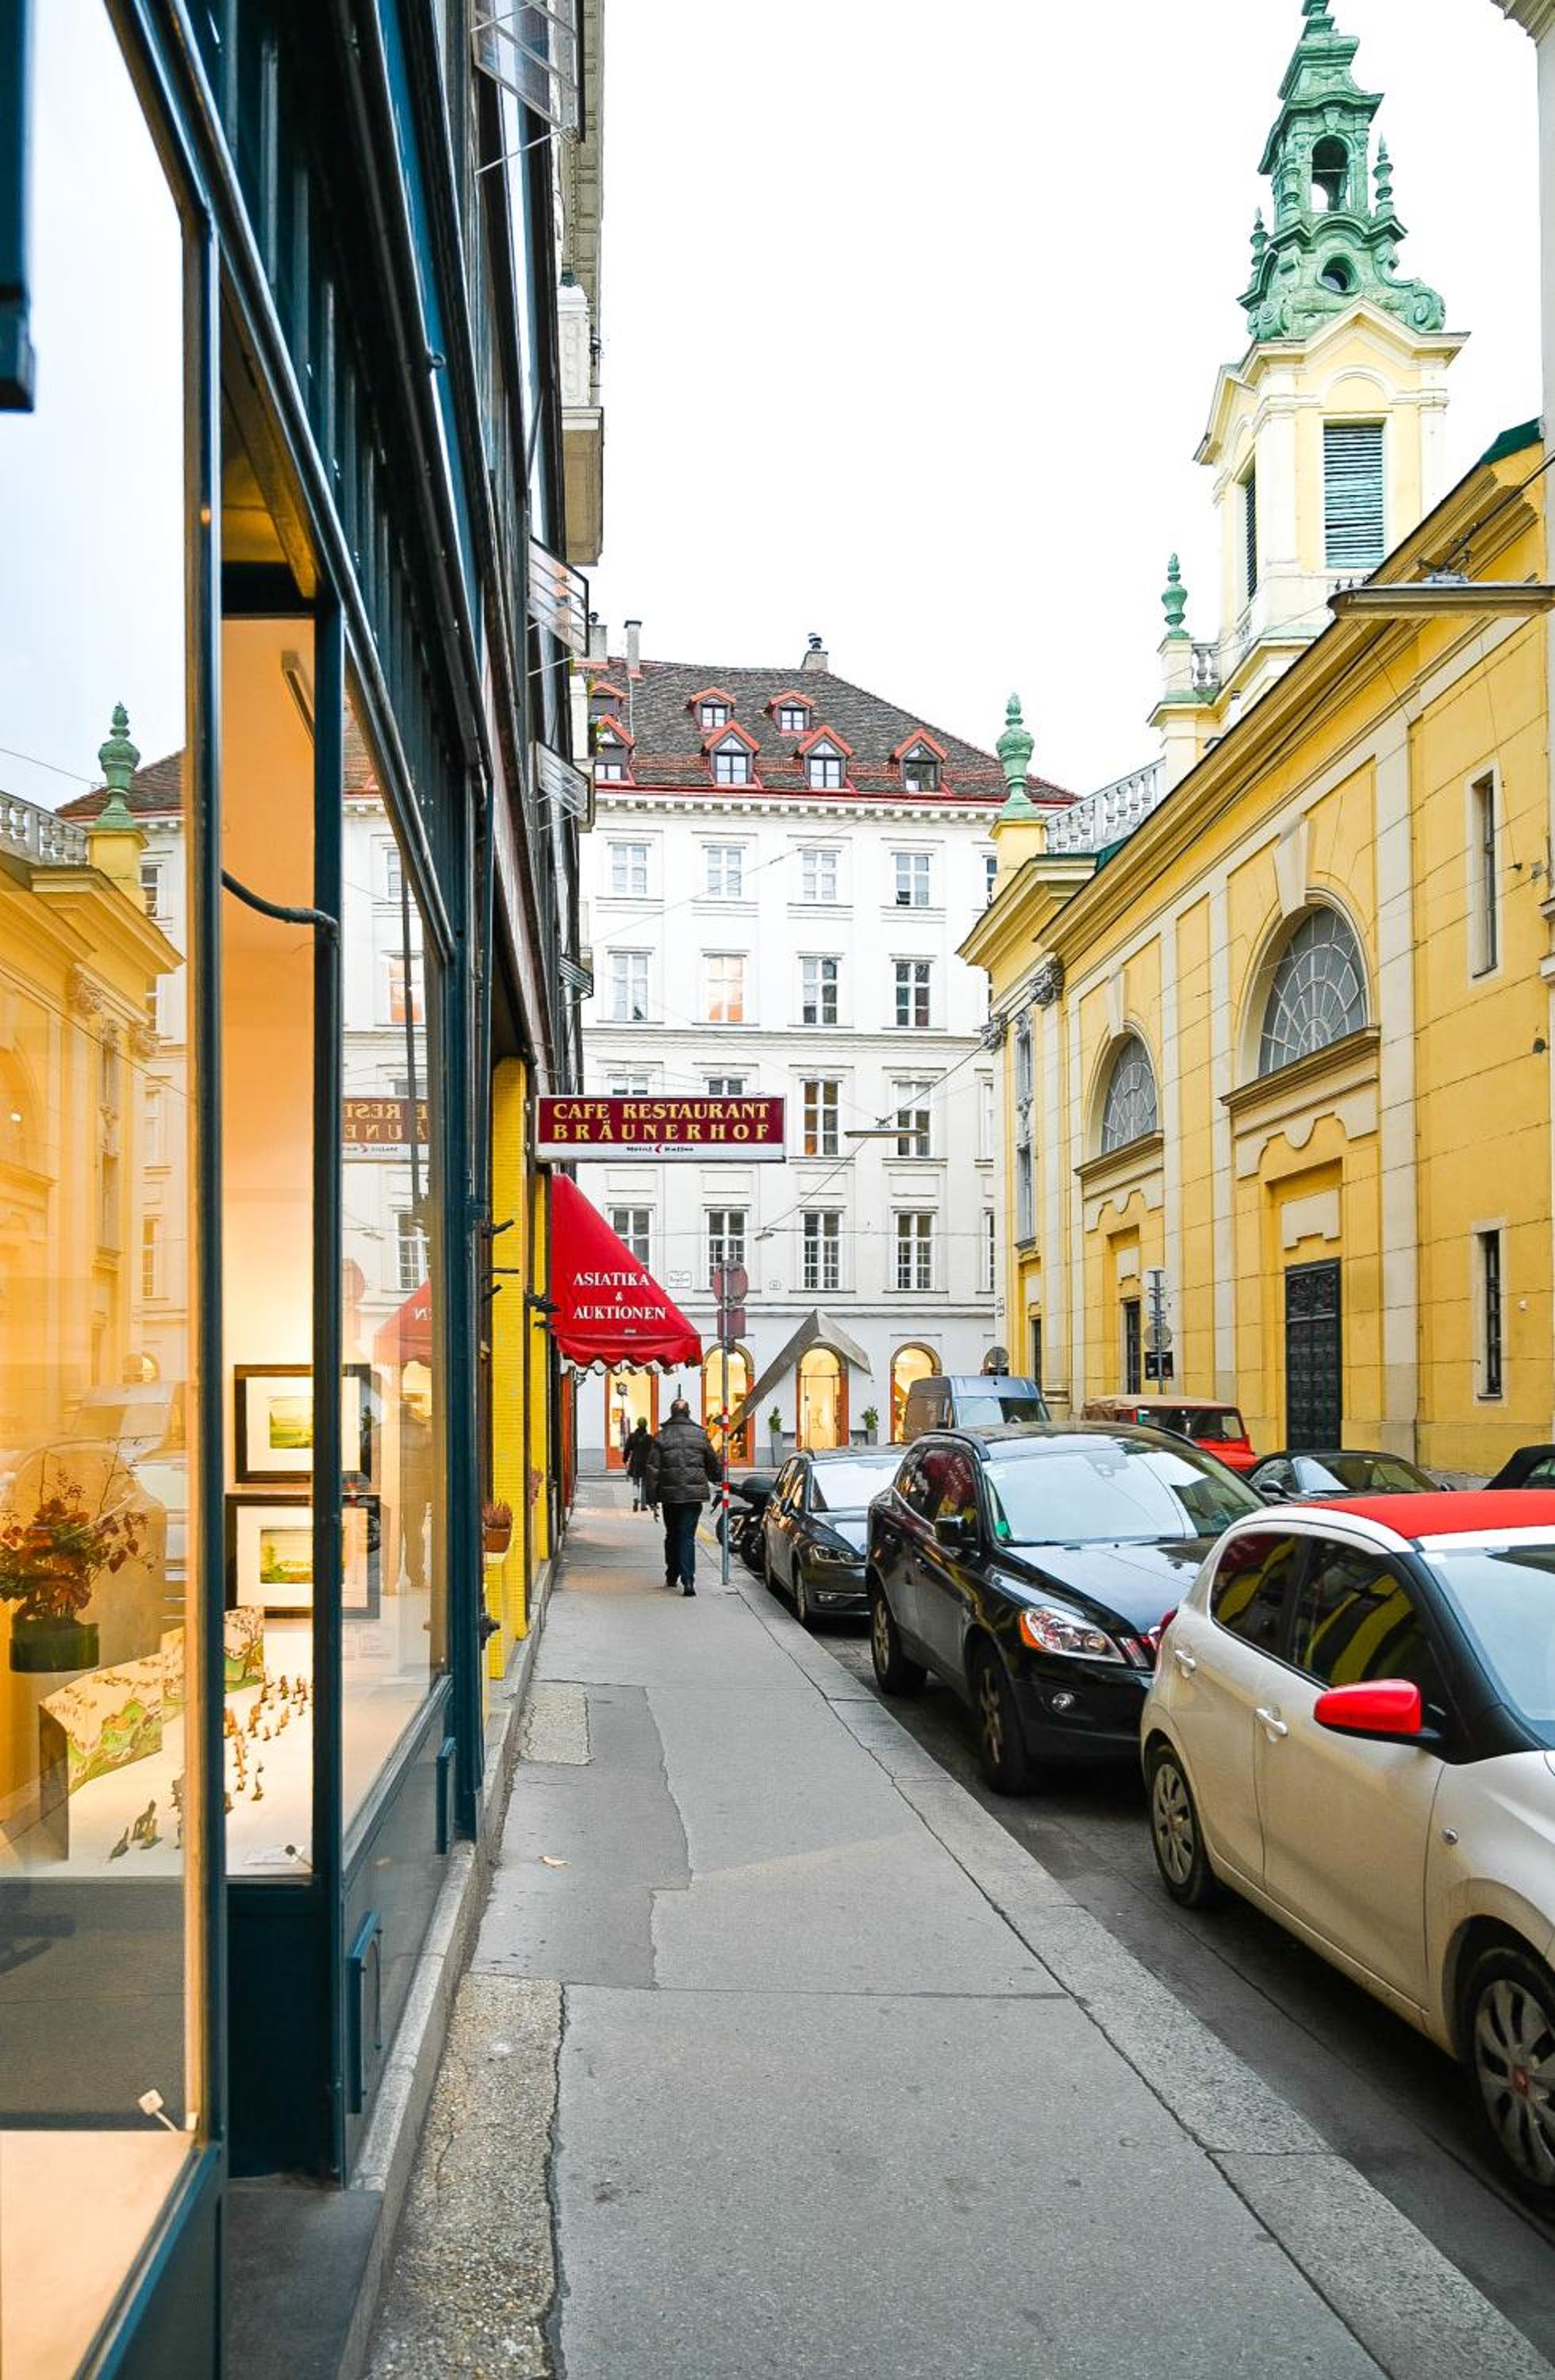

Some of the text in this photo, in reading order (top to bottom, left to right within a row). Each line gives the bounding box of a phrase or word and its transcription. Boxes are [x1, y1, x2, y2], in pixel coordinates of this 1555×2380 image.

[553, 1104, 770, 1119] CAFE RESTAURANT
[553, 1120, 770, 1140] BRÄUNERHOF
[573, 1272, 650, 1286] ASIATIKA
[615, 1291, 624, 1302] &
[573, 1306, 666, 1319] AUKTIONEN
